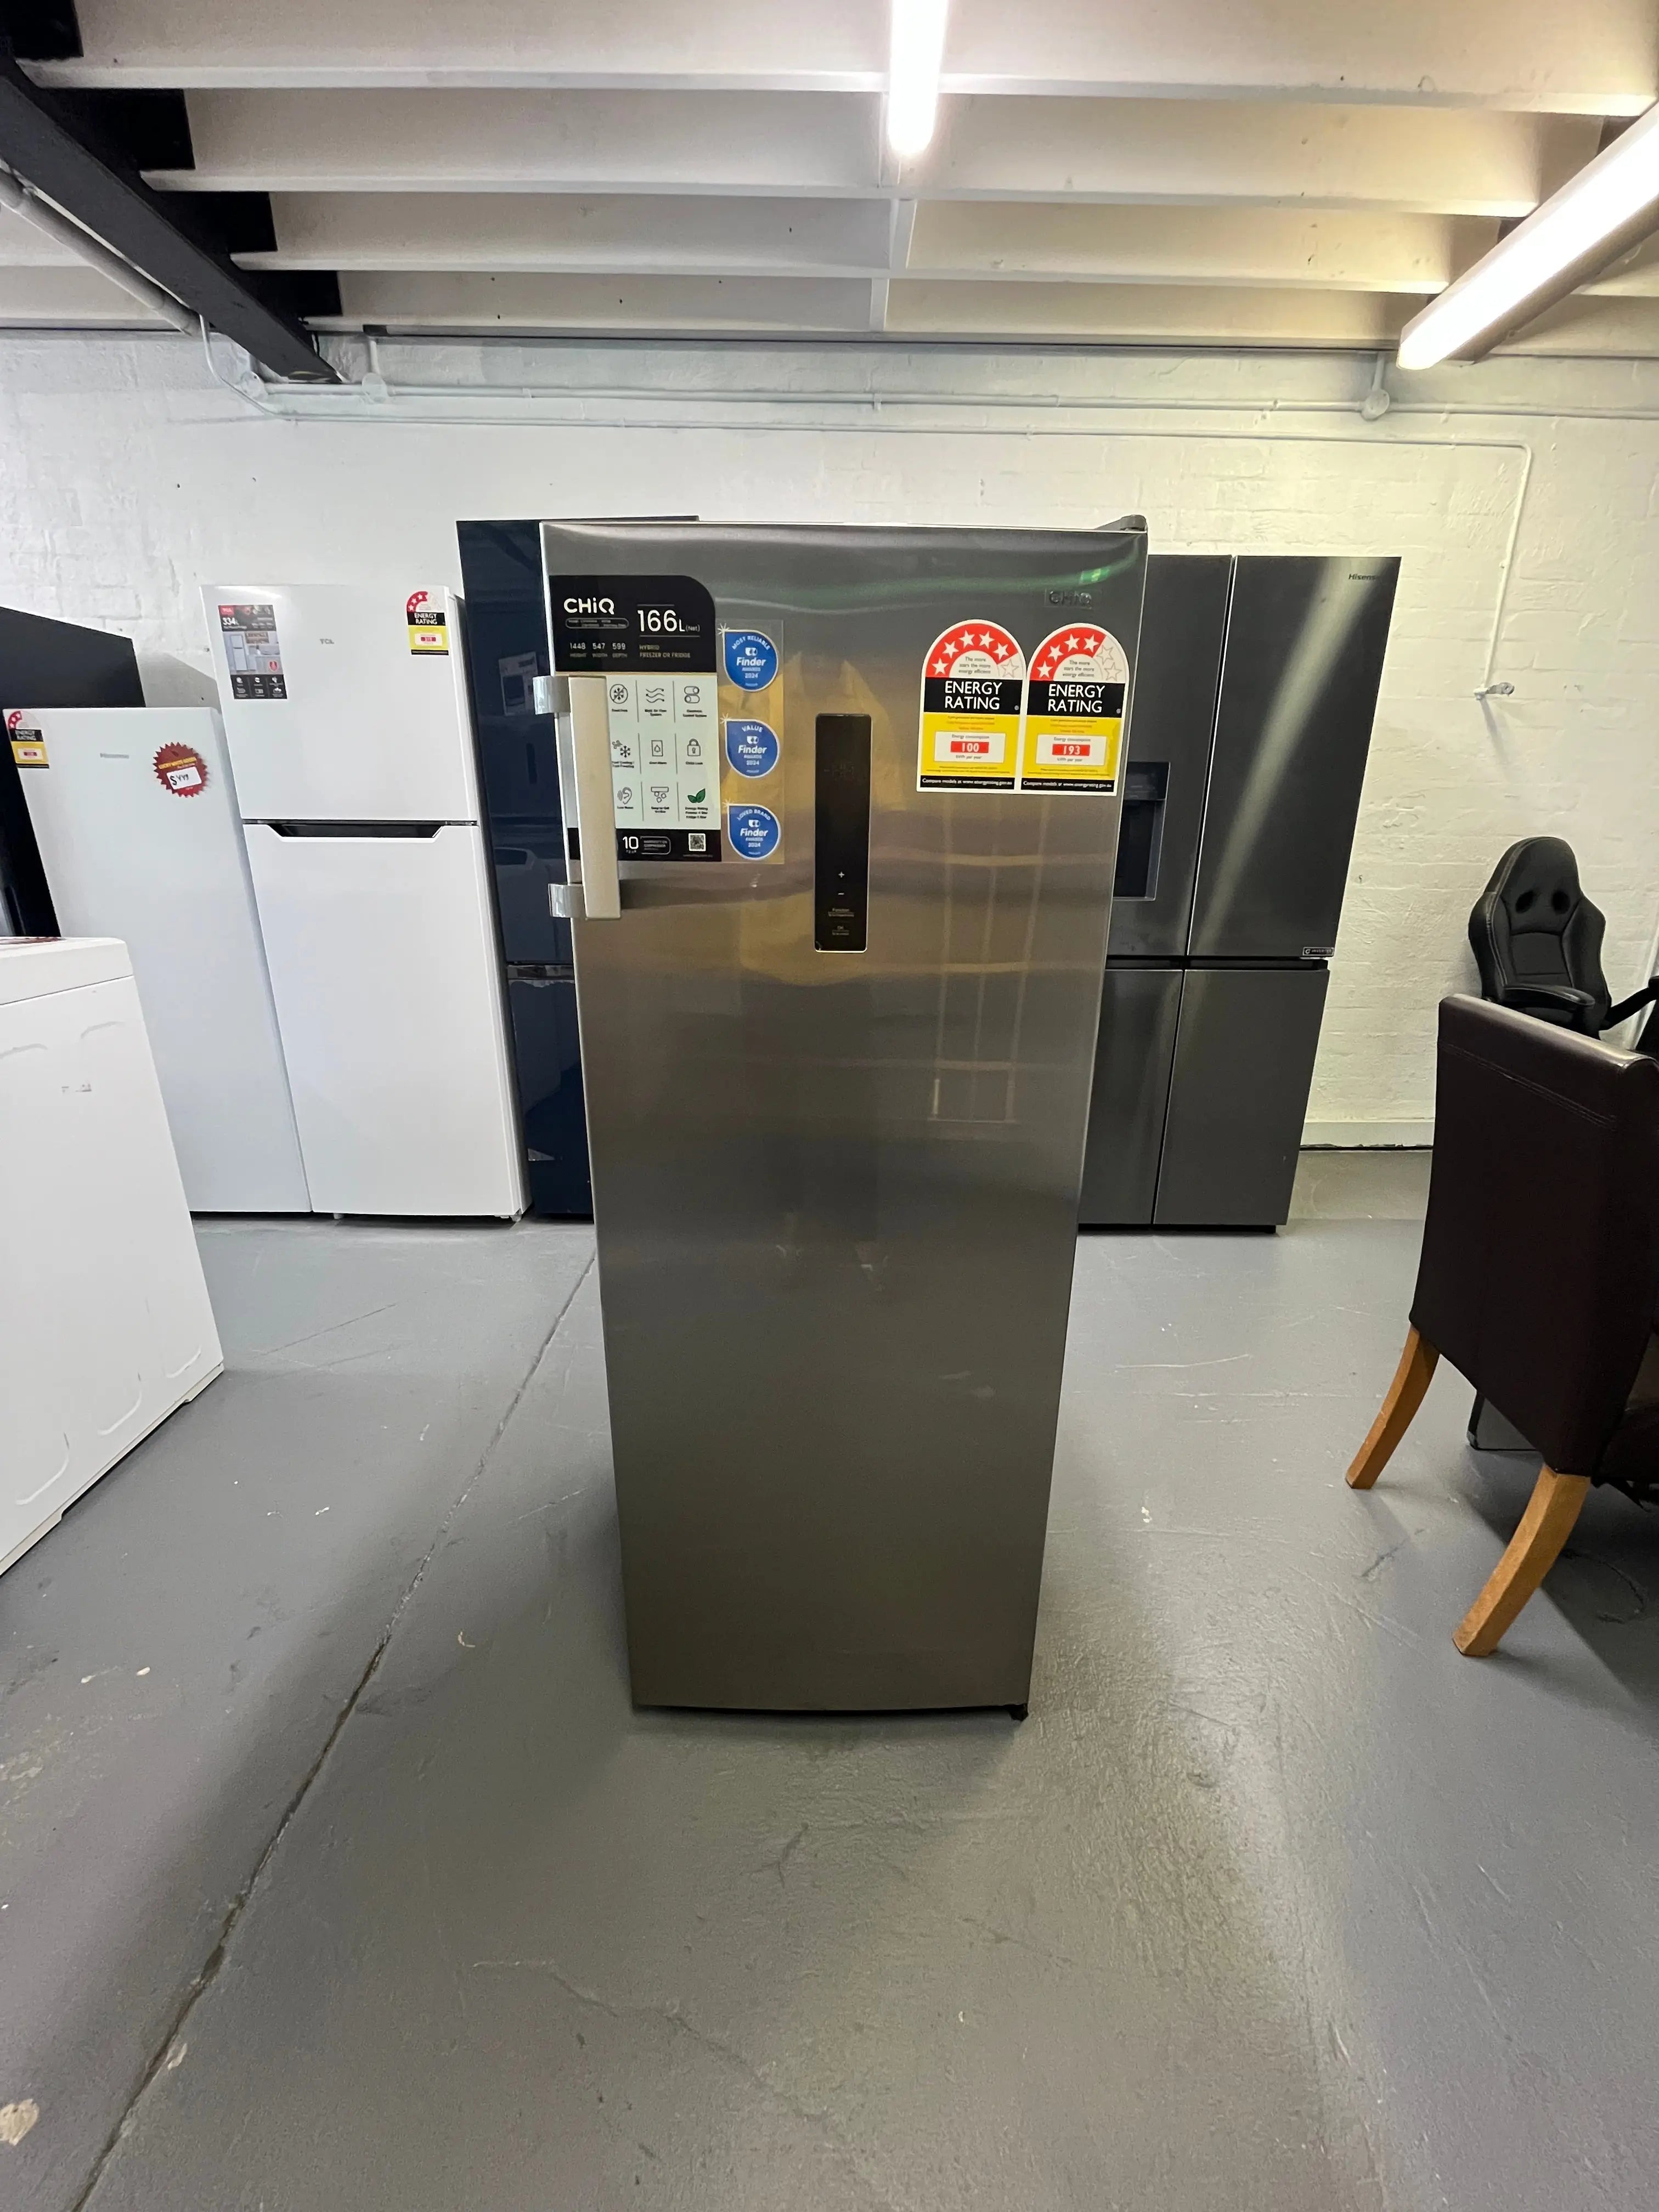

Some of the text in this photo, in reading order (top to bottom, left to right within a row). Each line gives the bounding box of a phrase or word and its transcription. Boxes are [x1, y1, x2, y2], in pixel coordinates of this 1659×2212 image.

[563, 597, 614, 615] CHiQ
[732, 635, 771, 650] MOST RELIABLE
[736, 656, 766, 666] Finder
[945, 680, 1002, 695] ENERGY
[1048, 684, 1105, 698] ENERGY
[944, 696, 1000, 710] RATING
[1048, 699, 1103, 713] RATING
[742, 725, 763, 733] VALUE
[738, 744, 768, 754] Finder
[962, 743, 979, 753] 100
[1063, 745, 1081, 755] 193
[740, 828, 769, 837] Finder
[622, 836, 639, 850] 10
